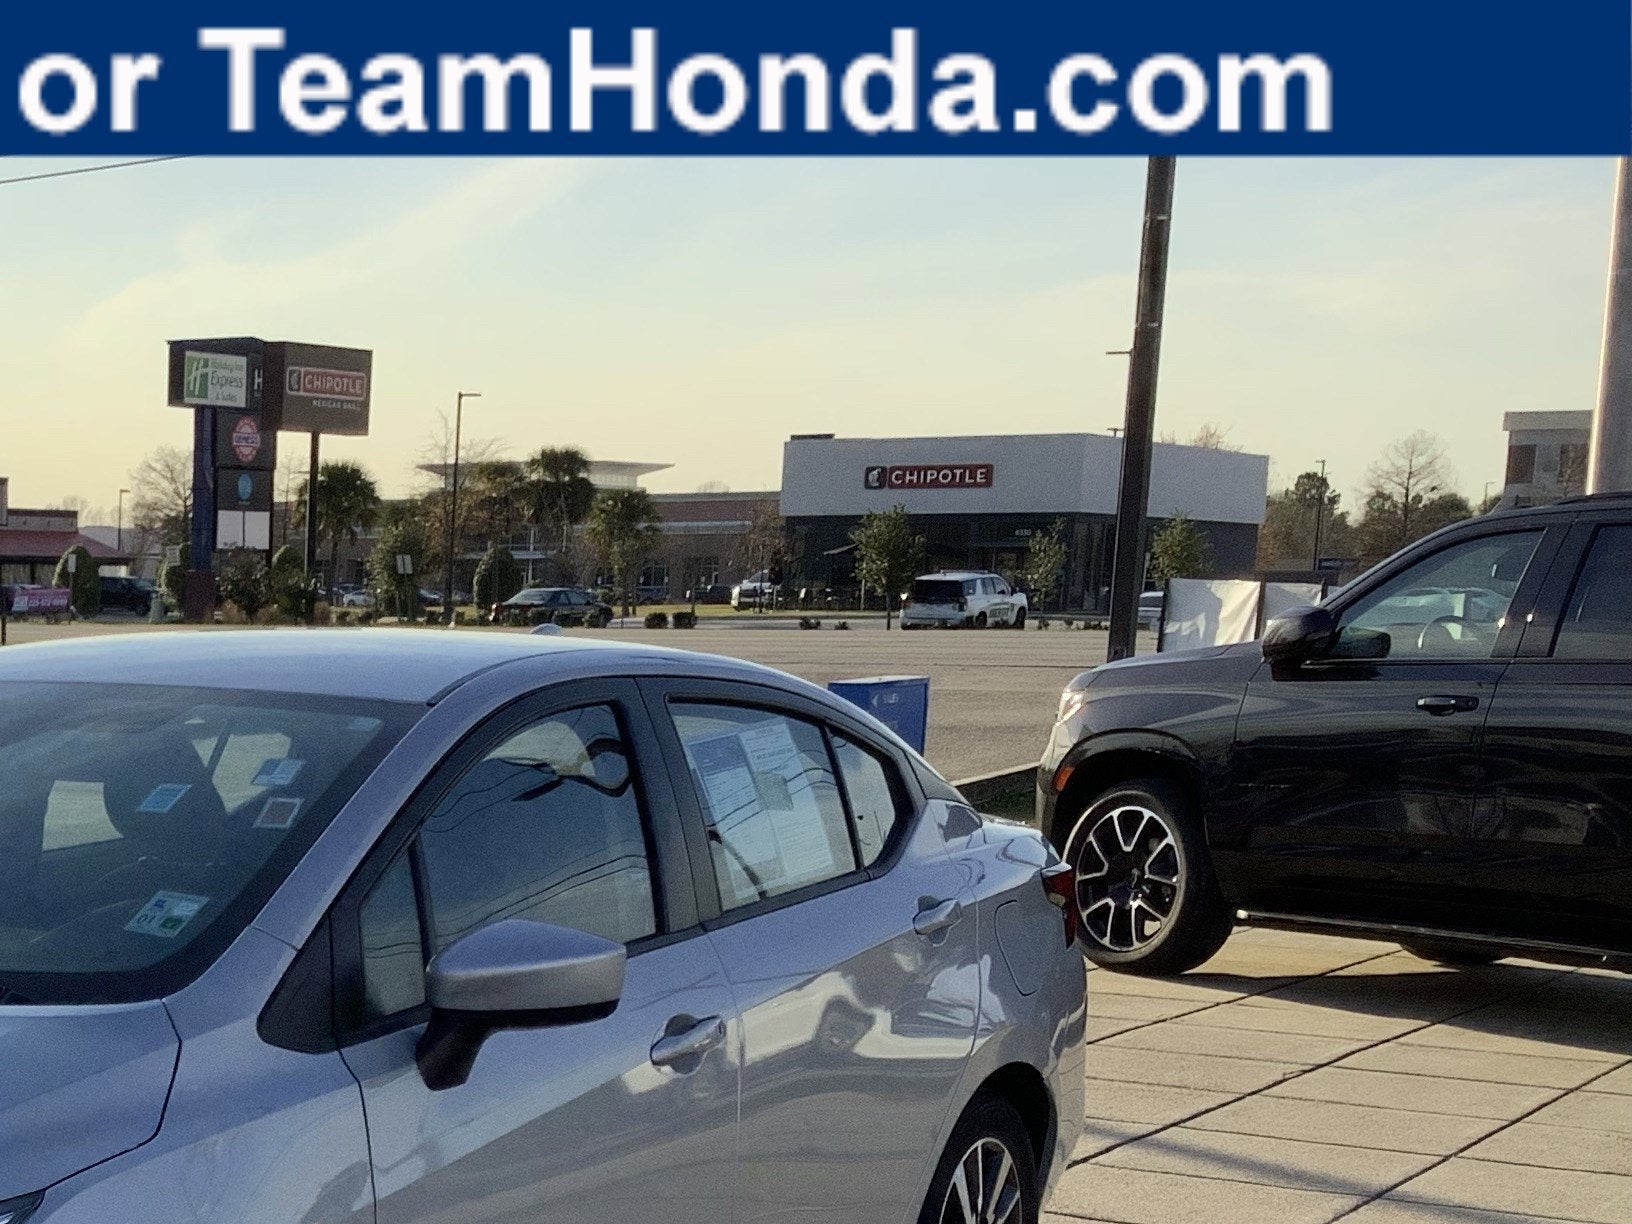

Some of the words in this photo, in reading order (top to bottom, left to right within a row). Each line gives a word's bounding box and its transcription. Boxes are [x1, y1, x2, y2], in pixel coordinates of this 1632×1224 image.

[210, 370, 244, 390] Express
[304, 374, 363, 394] CHIPOTLE
[891, 467, 988, 485] CHIPOTLE
